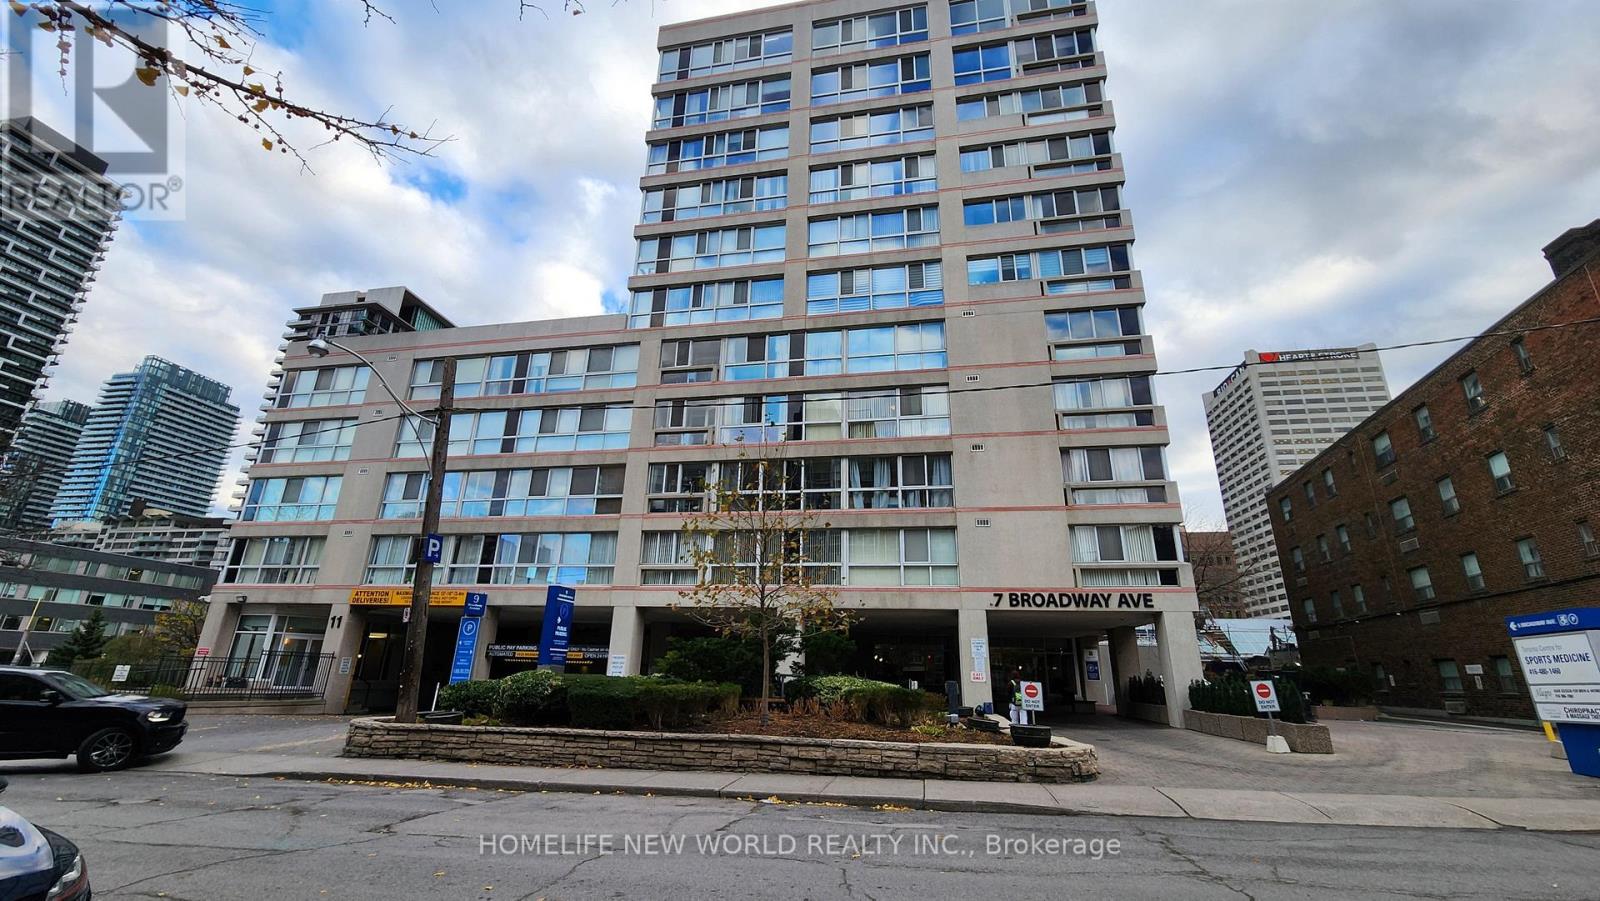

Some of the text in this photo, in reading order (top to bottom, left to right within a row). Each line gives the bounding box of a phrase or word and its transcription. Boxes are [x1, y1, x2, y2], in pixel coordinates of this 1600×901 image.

[473, 595, 480, 604] 9
[1008, 593, 1112, 608] BROADWAY
[1117, 593, 1155, 608] AVE
[331, 615, 343, 629] 11
[1525, 653, 1591, 665] SPORTS MEDICINE
